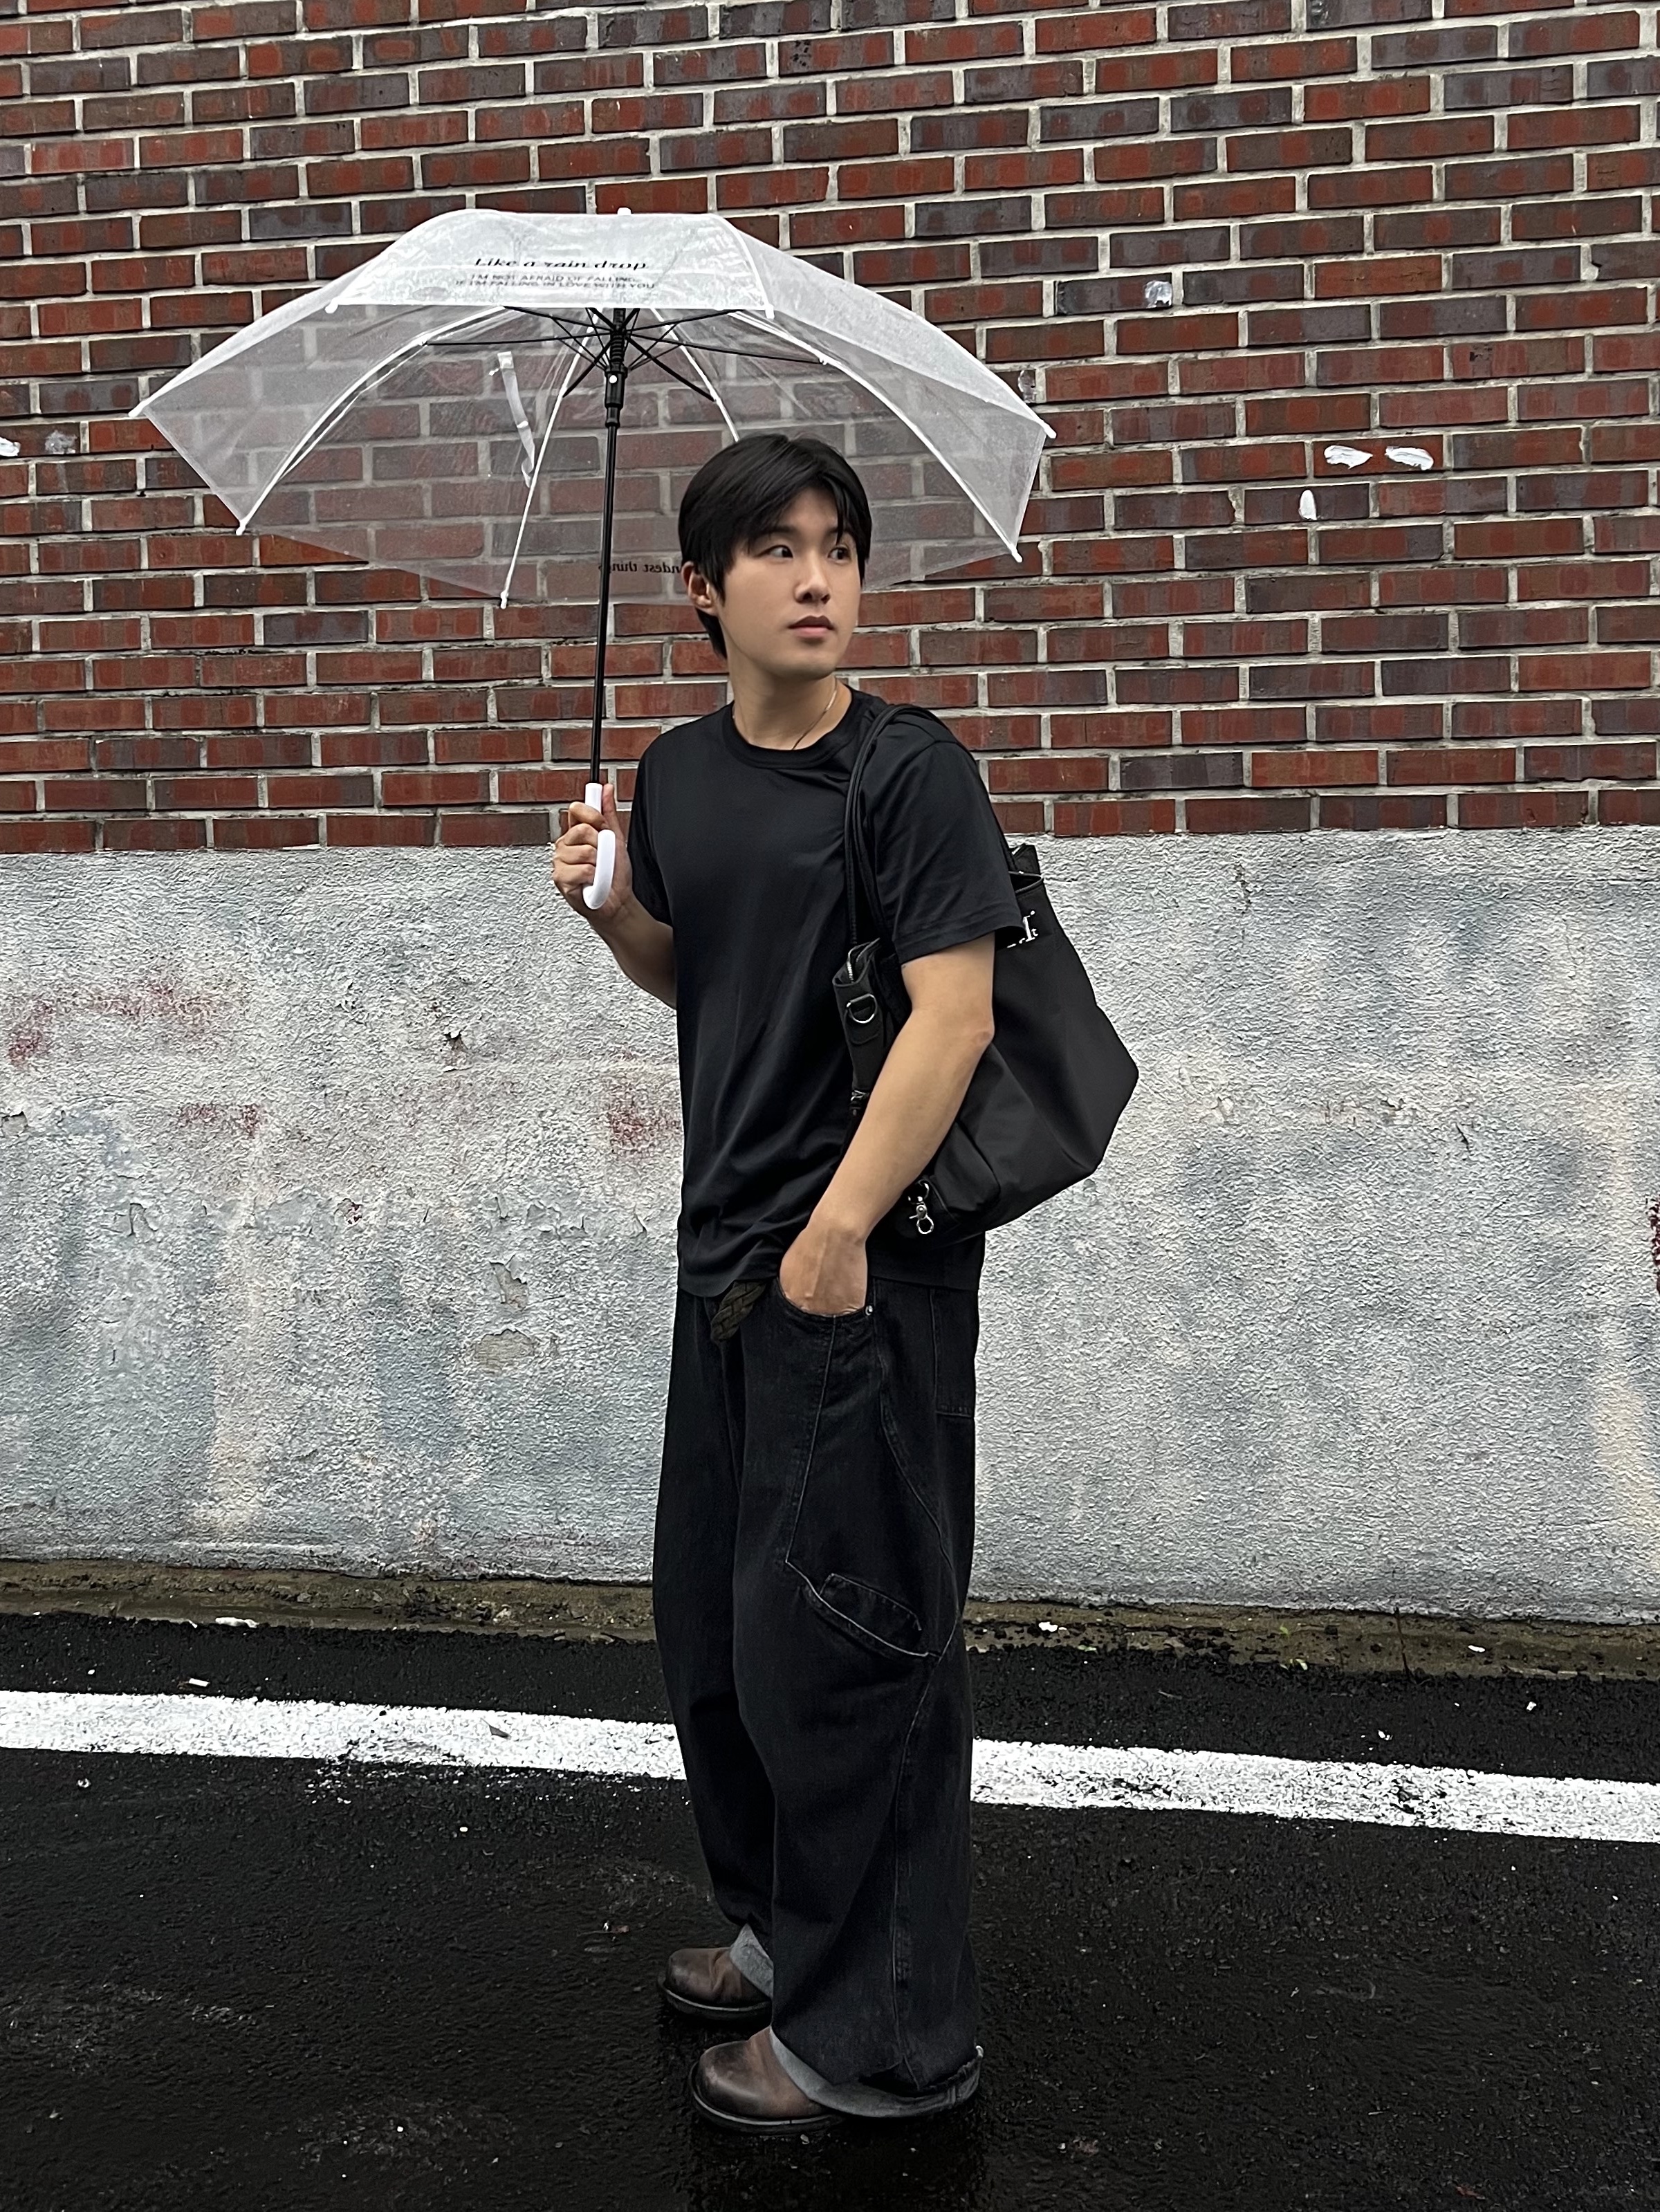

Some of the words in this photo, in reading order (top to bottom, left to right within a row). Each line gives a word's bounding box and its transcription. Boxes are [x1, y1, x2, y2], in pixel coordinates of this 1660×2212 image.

[474, 258, 519, 266] Like
[544, 260, 588, 268] rain
[594, 260, 649, 270] drop
